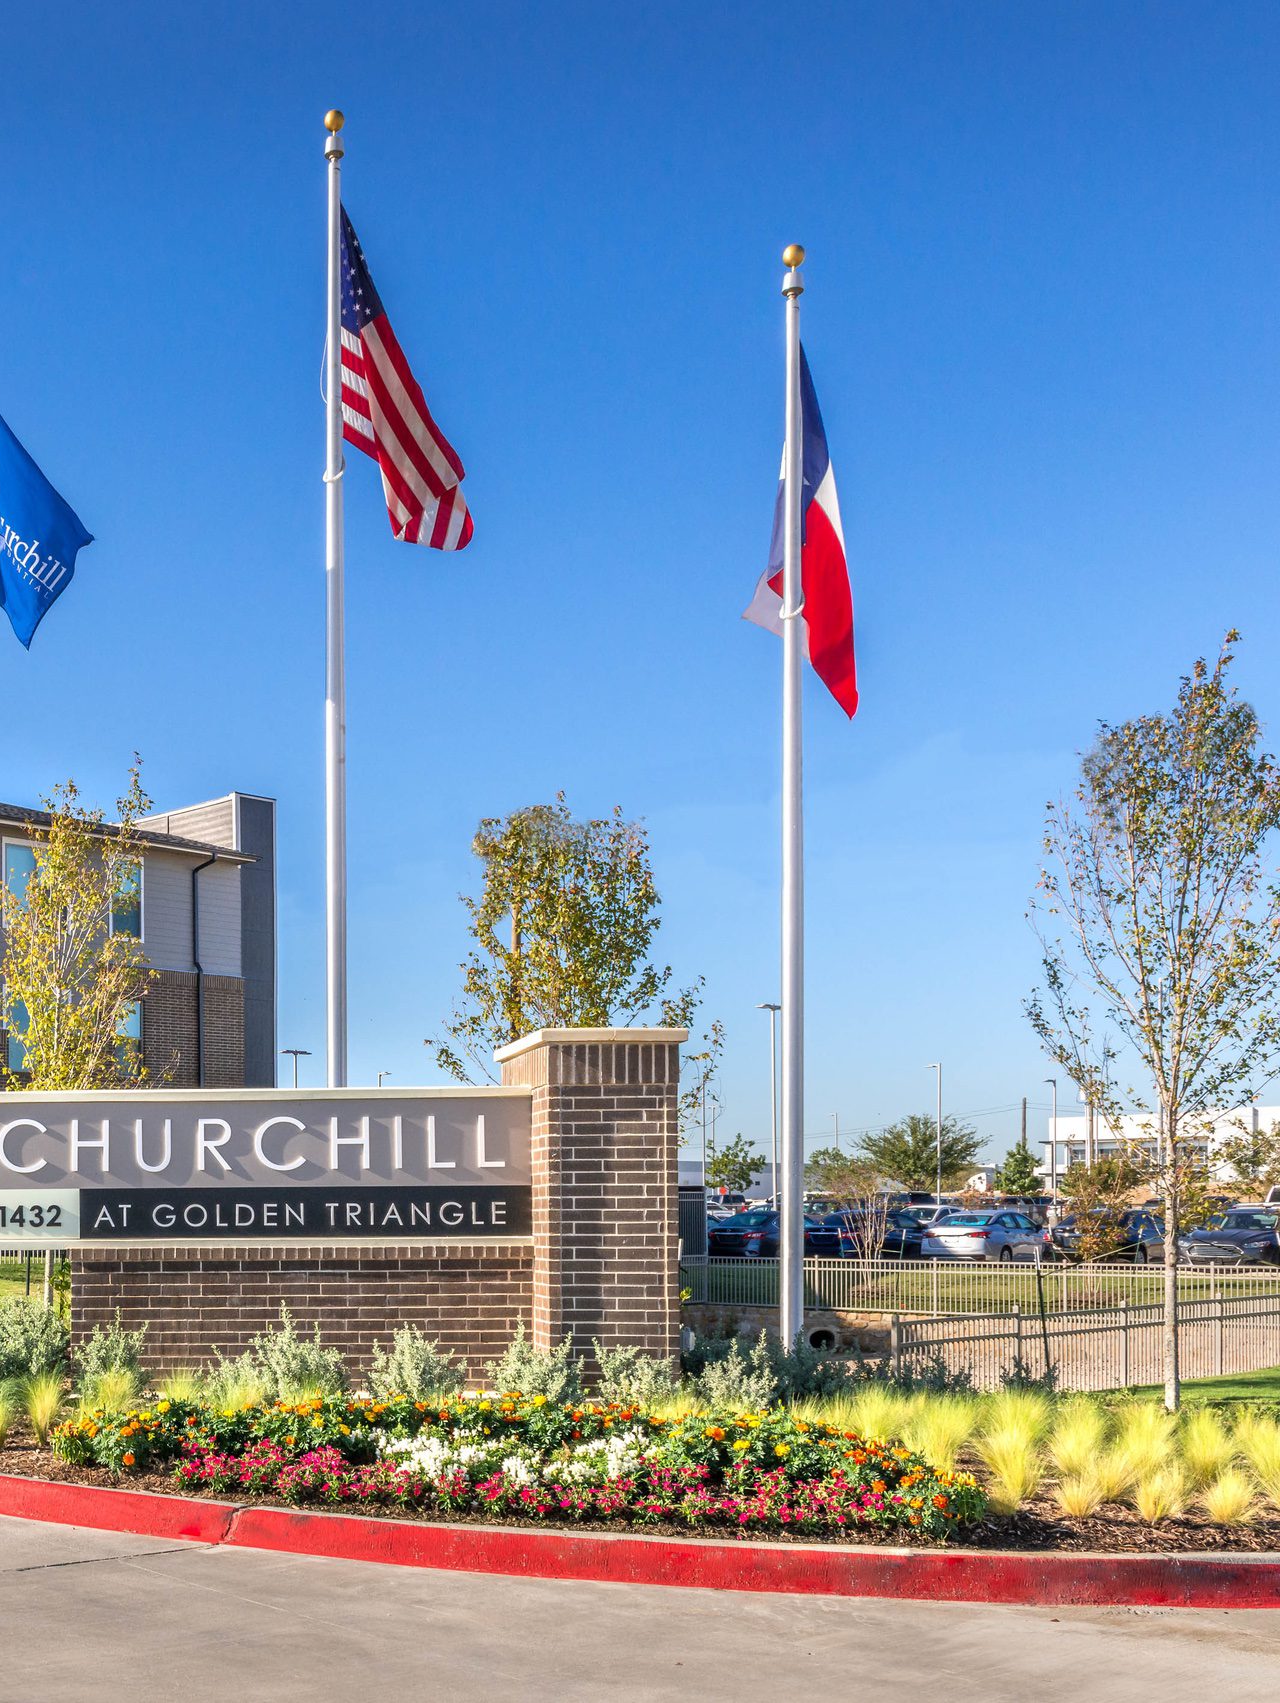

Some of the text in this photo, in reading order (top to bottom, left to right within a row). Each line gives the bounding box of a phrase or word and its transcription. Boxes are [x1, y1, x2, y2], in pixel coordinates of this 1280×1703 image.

[0, 516, 67, 592] urchill
[94, 1201, 507, 1228] AT GOLDEN TRIANGLE
